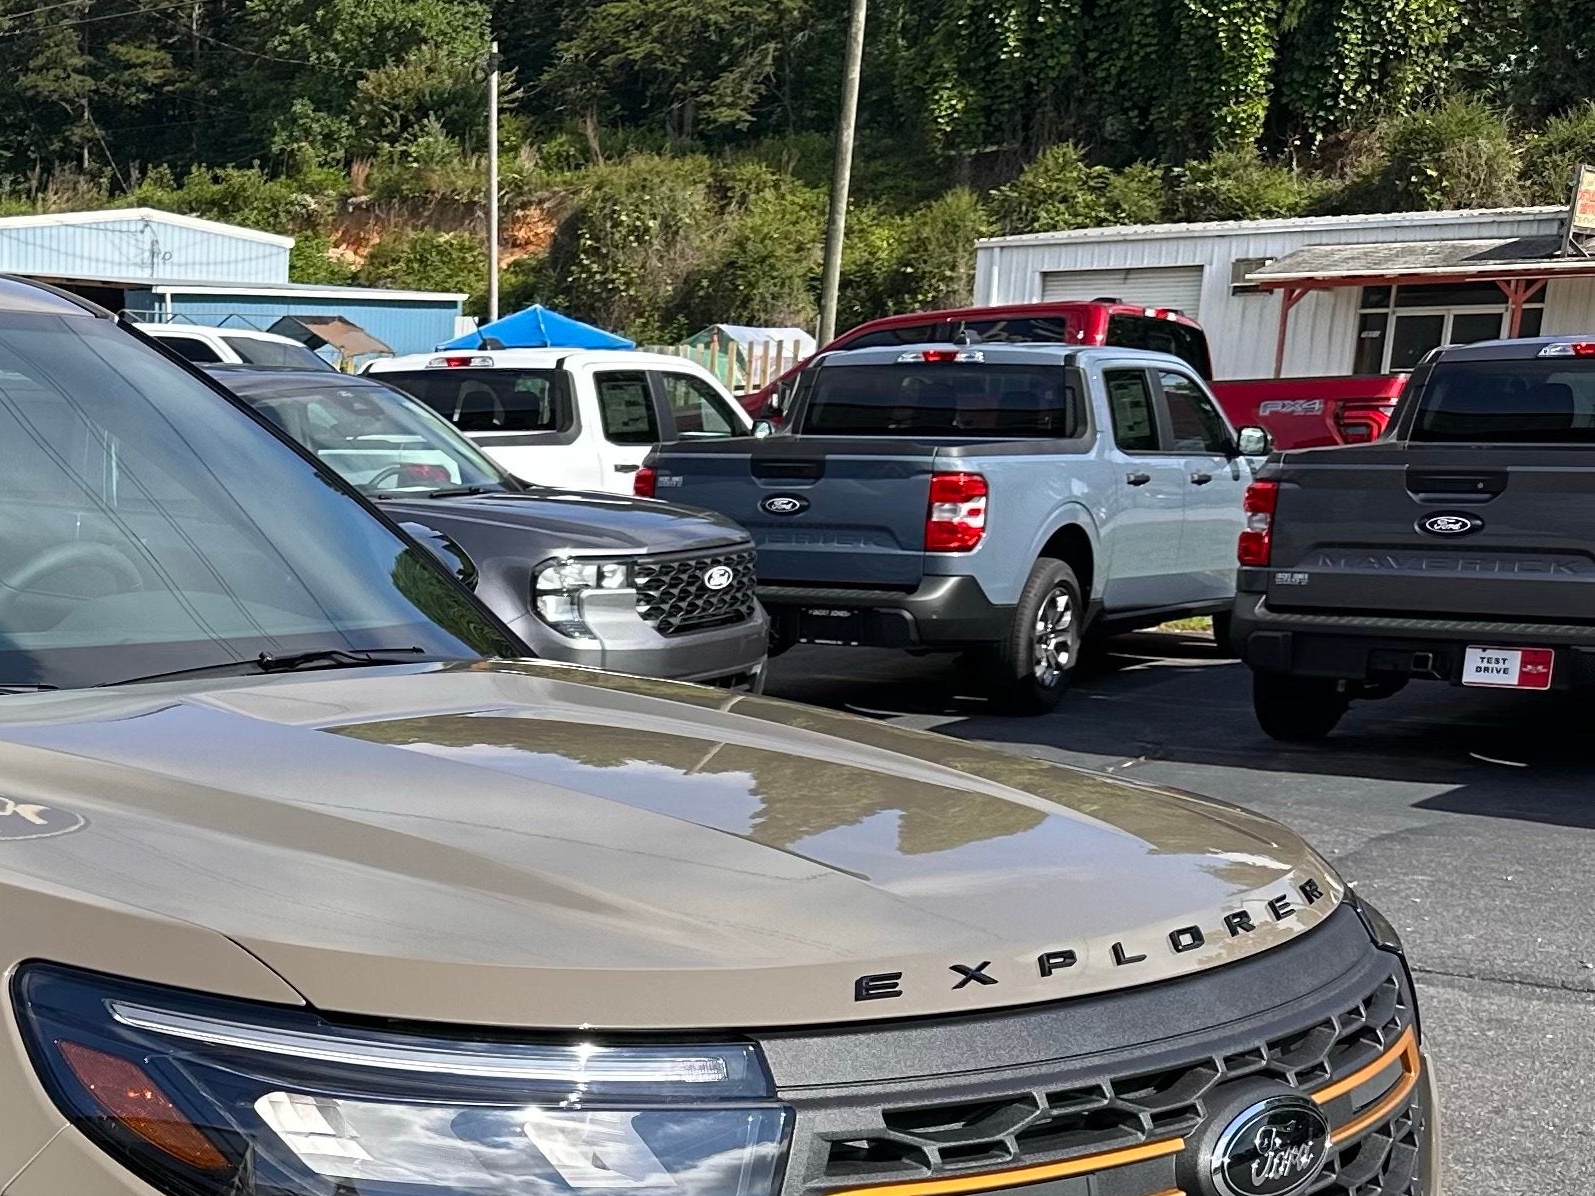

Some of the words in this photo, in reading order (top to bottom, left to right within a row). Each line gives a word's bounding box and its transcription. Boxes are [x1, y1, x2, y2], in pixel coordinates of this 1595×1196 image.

[1475, 666, 1509, 674] DRIVE
[1479, 656, 1508, 665] TEST
[854, 877, 1324, 1001] EXPLORER
[1251, 1119, 1314, 1187] Ford
